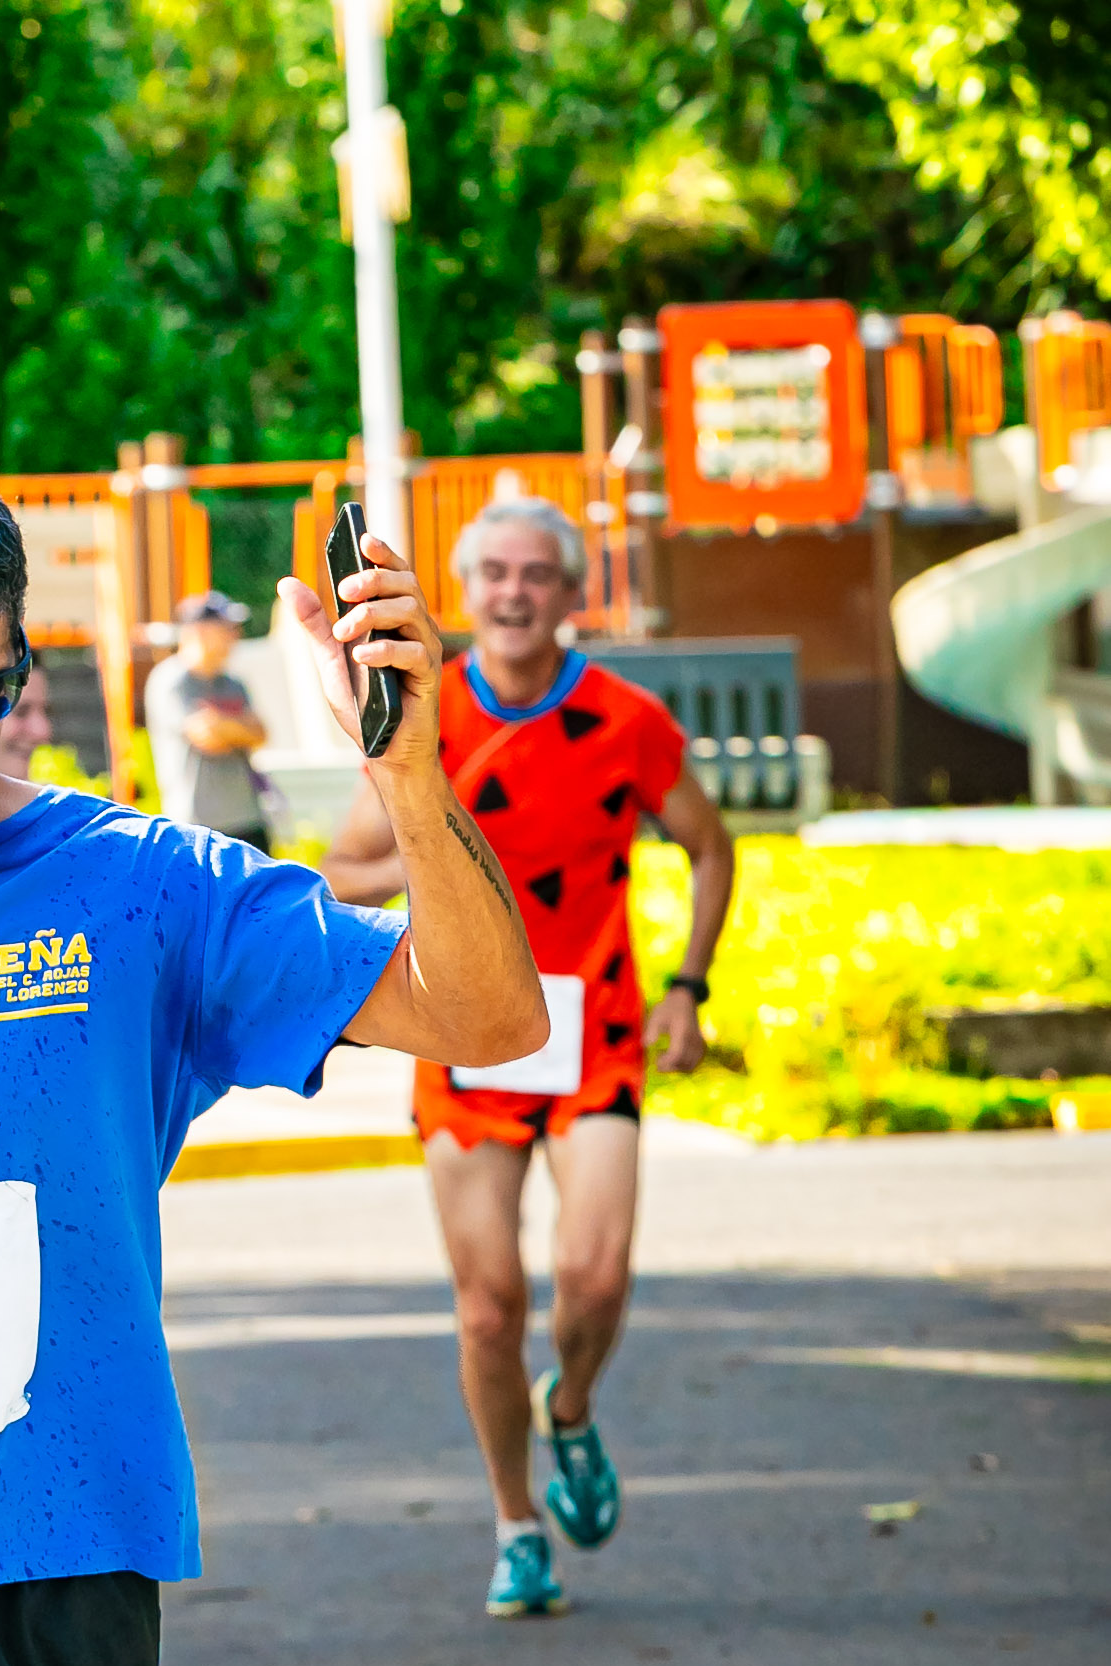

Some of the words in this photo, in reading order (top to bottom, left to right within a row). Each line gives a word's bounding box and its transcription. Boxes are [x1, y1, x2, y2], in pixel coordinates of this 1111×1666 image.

[23, 973, 37, 987] C.
[43, 965, 90, 982] ROJAS
[6, 979, 89, 1003] LORENZO
